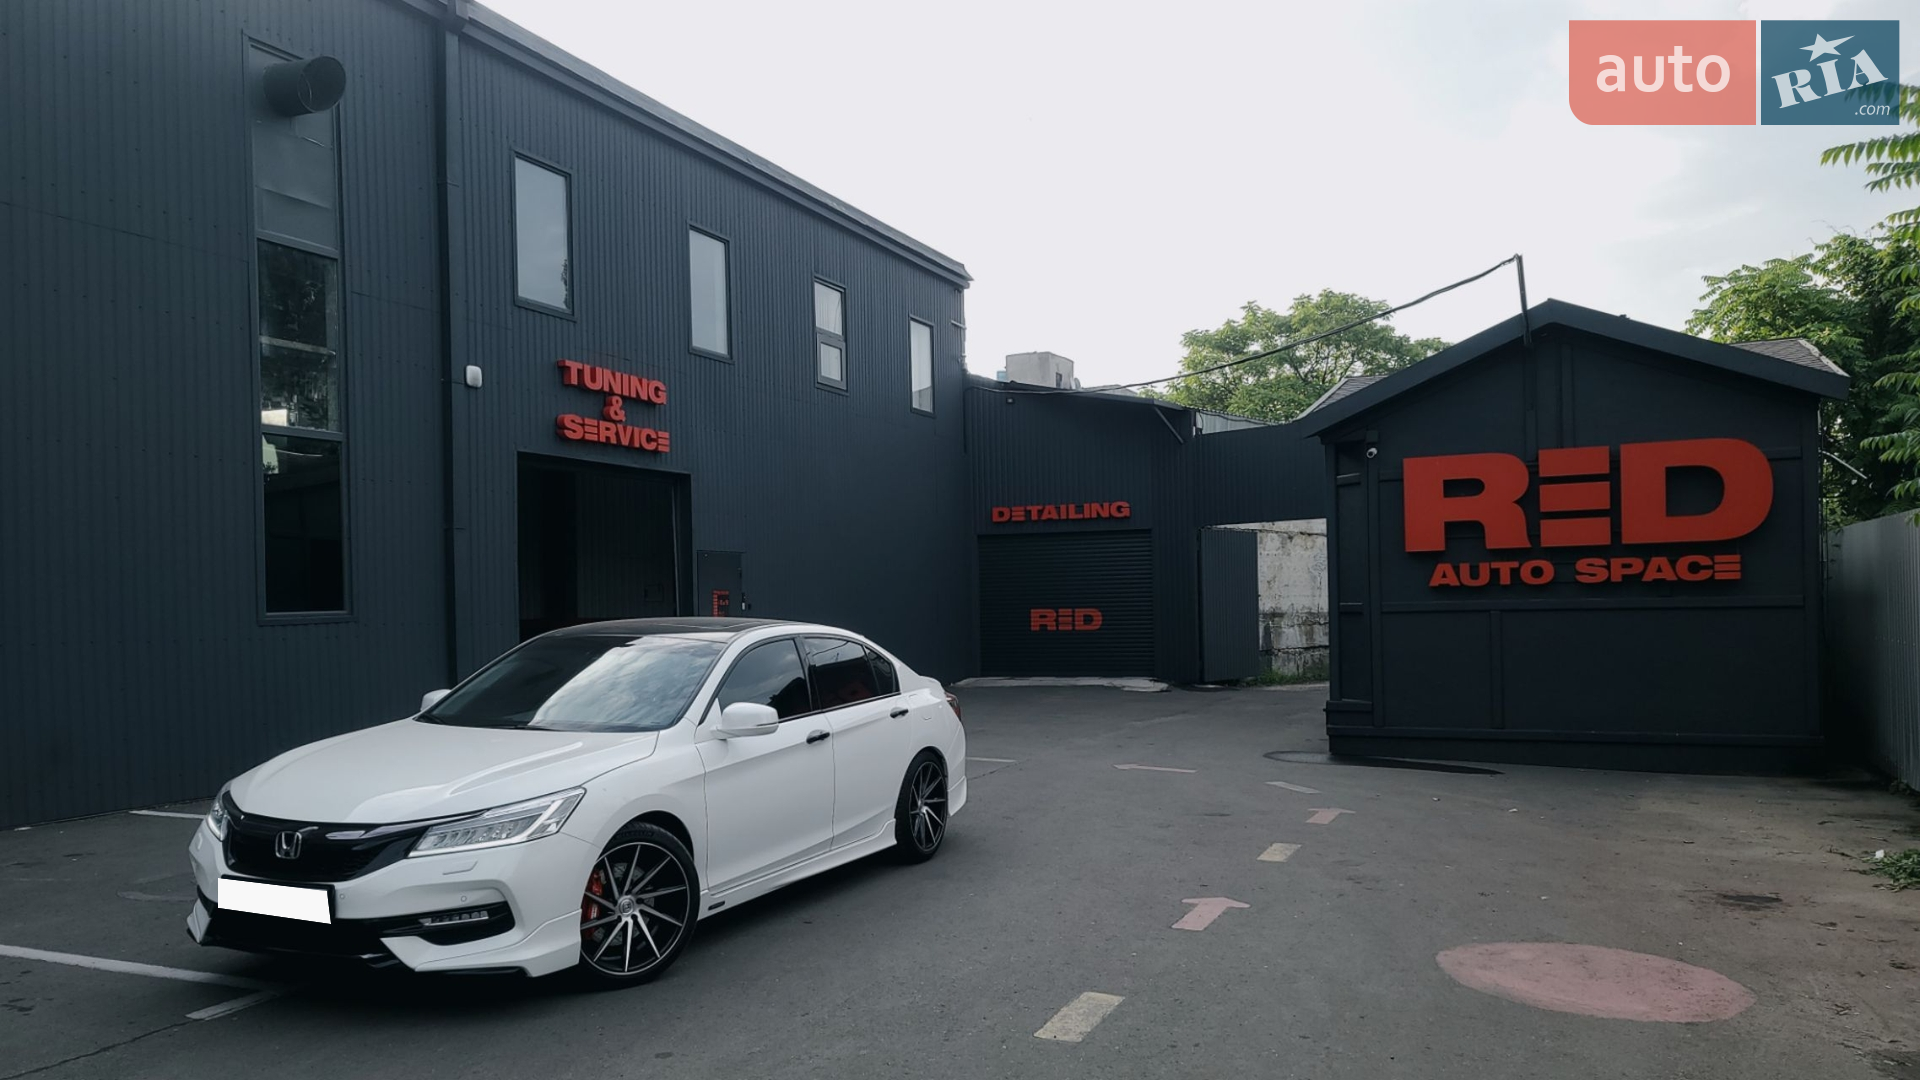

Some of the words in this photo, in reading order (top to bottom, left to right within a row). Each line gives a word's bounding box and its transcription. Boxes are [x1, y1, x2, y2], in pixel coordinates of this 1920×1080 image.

[559, 360, 667, 405] TUNING
[604, 395, 626, 422] &
[558, 414, 670, 453] SERVICE
[992, 501, 1131, 523] DETAILING
[1403, 438, 1774, 552] RED
[1428, 559, 1555, 588] AUTO
[1574, 554, 1742, 584] SPACE
[1030, 608, 1103, 631] RED
